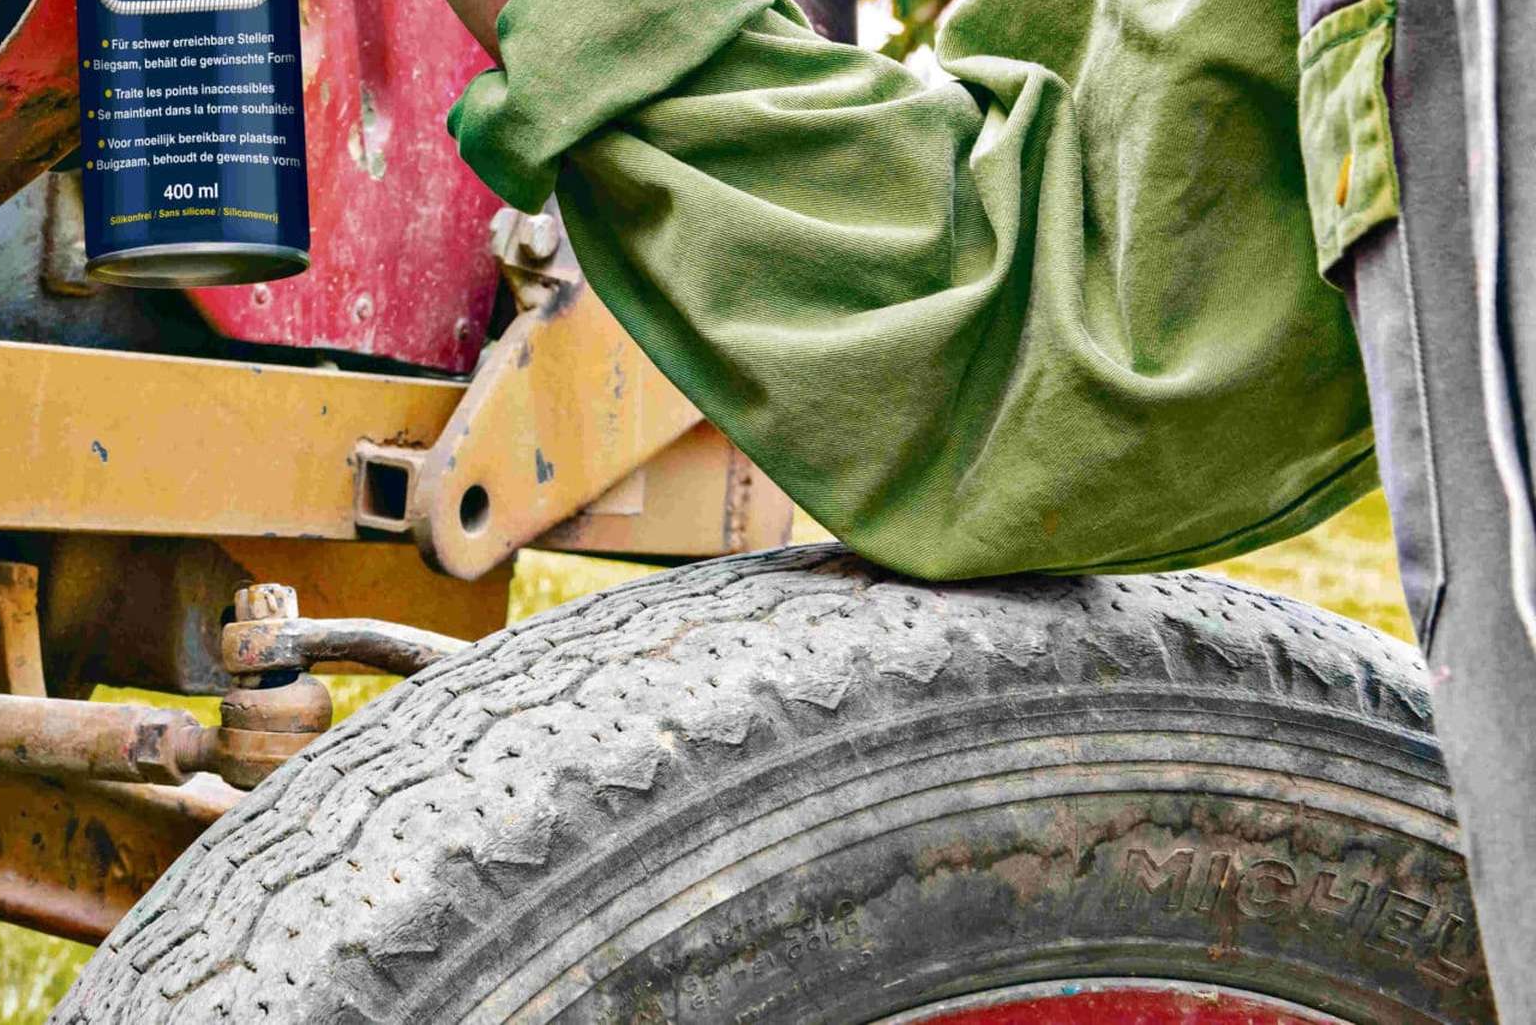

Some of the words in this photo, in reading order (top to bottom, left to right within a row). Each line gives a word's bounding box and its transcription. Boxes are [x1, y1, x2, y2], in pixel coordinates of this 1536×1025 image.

[111, 38, 129, 50] Für
[132, 38, 170, 50] schwer
[173, 34, 234, 48] erreichbare
[237, 32, 275, 45] Stellen
[93, 59, 142, 73] Biegsam,
[144, 56, 178, 69] behält
[181, 55, 197, 67] die
[200, 53, 265, 69] gewünschte
[268, 52, 296, 64] Form
[114, 88, 144, 100] Traite
[147, 86, 163, 98] les
[165, 84, 199, 100] points
[201, 82, 275, 95] inaccessibles
[97, 109, 112, 121] Se
[114, 106, 163, 120] maintient
[165, 105, 192, 117] dans
[194, 104, 204, 115] la
[207, 103, 239, 115] forme
[241, 102, 295, 115] souhaitée
[107, 137, 132, 149] Voor
[134, 133, 176, 147] moeilijk
[178, 132, 237, 144] bereikbare
[239, 132, 287, 146] plaatsen
[153, 152, 197, 166] behoudt
[200, 152, 214, 163] de
[217, 153, 270, 165] gewenste
[272, 155, 301, 167] vorm
[163, 182, 194, 201] 400
[198, 182, 219, 199] ml
[159, 208, 180, 219] Sans
[182, 207, 216, 217] silicone
[1118, 845, 1470, 988] MICHEL
